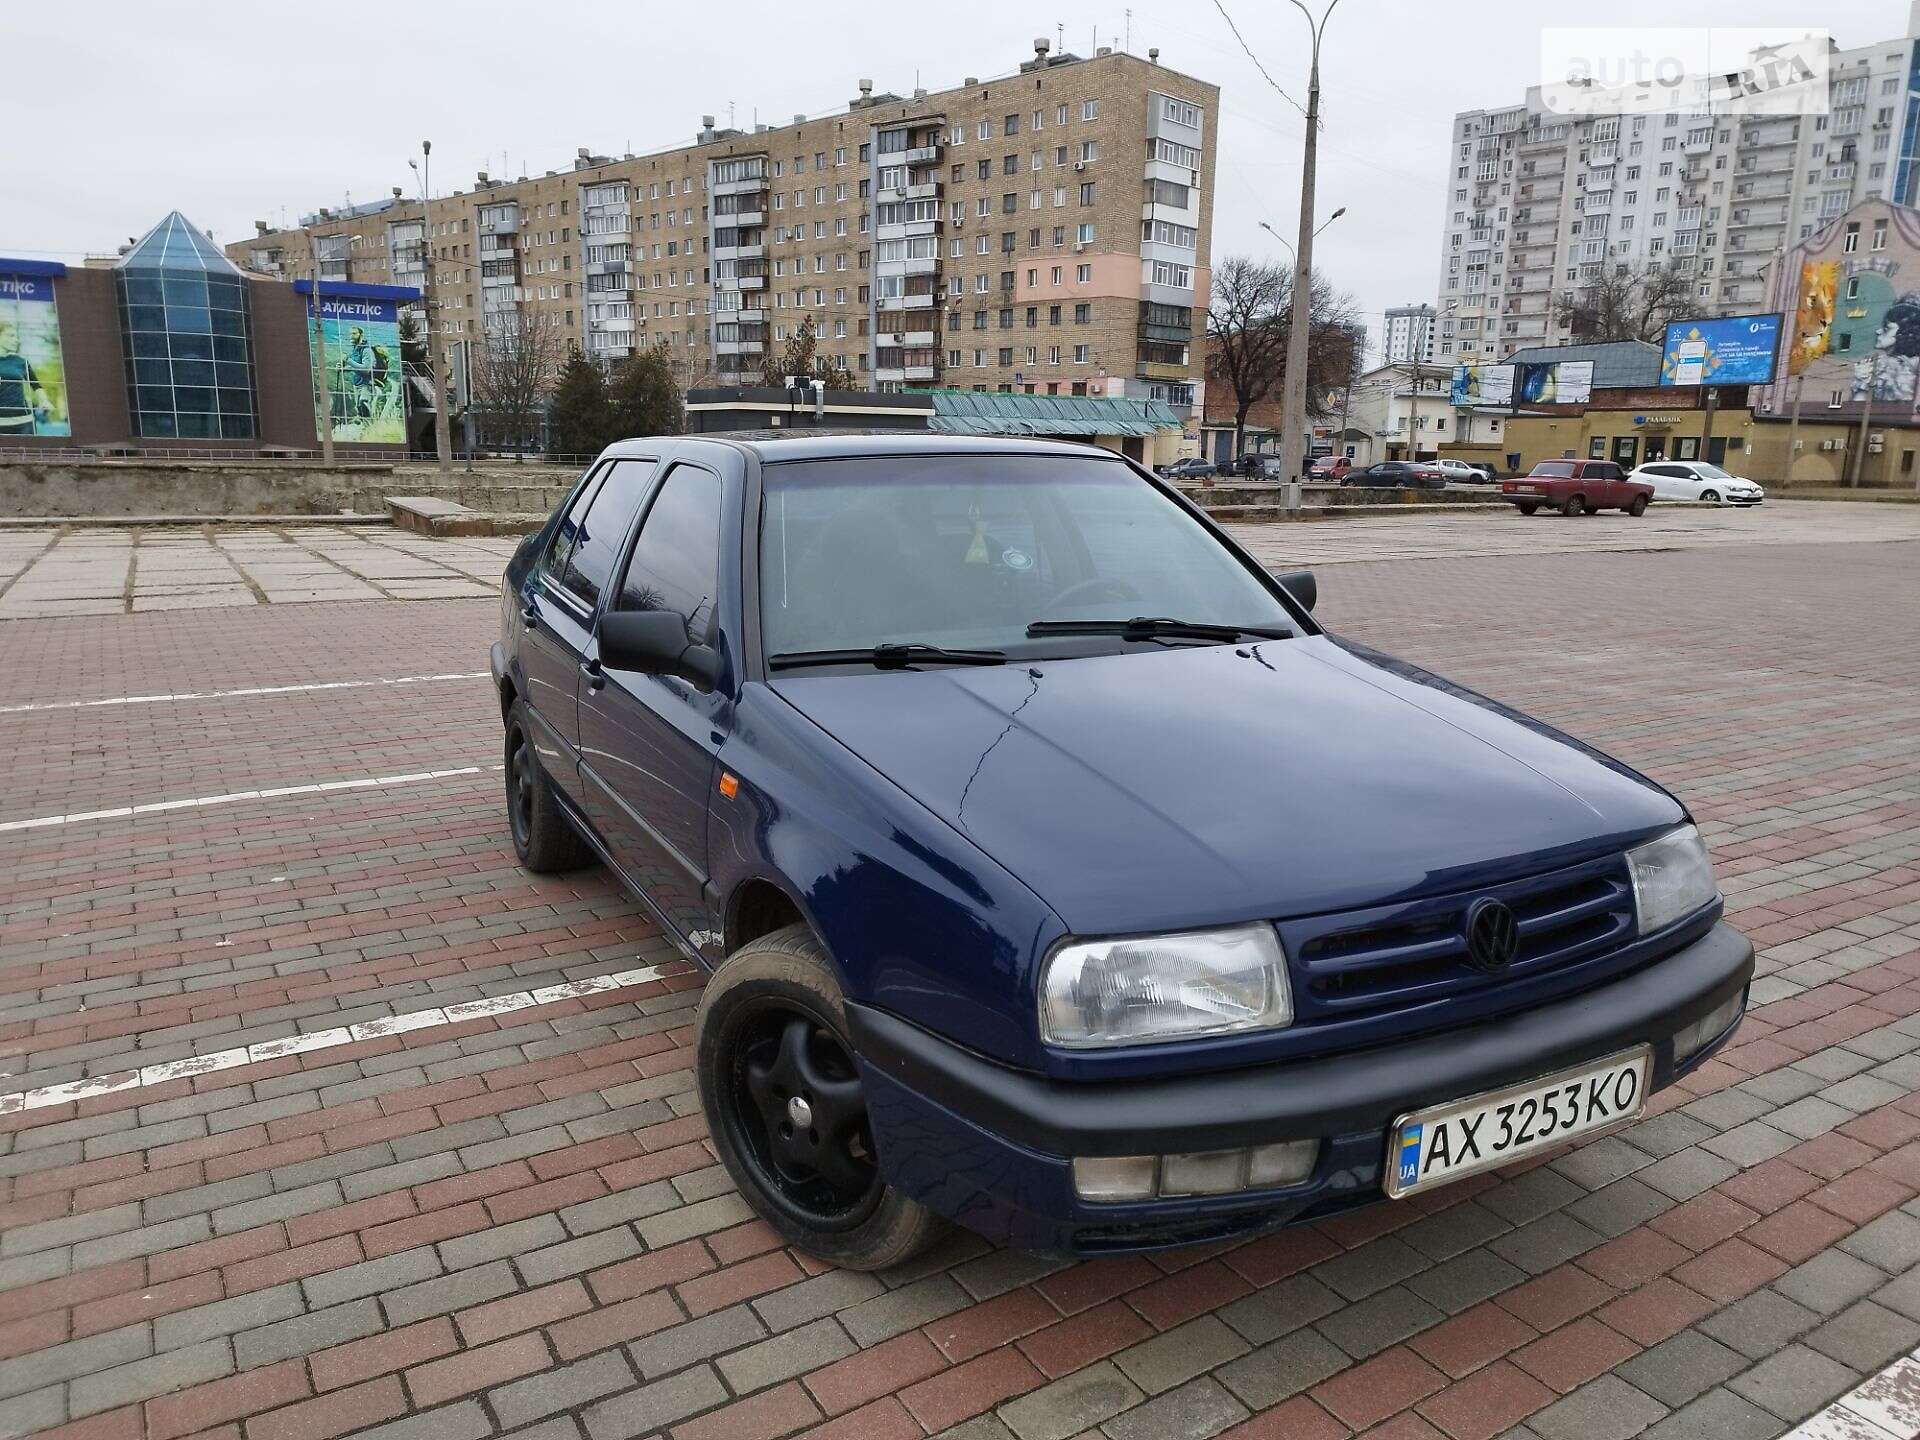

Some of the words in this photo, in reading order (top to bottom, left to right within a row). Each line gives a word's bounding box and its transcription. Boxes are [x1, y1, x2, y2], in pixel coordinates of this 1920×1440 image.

[1423, 1112, 1486, 1174] AX
[1492, 1082, 1582, 1151] 3253
[1586, 1067, 1637, 1123] KO
[1399, 1162, 1416, 1180] UA
